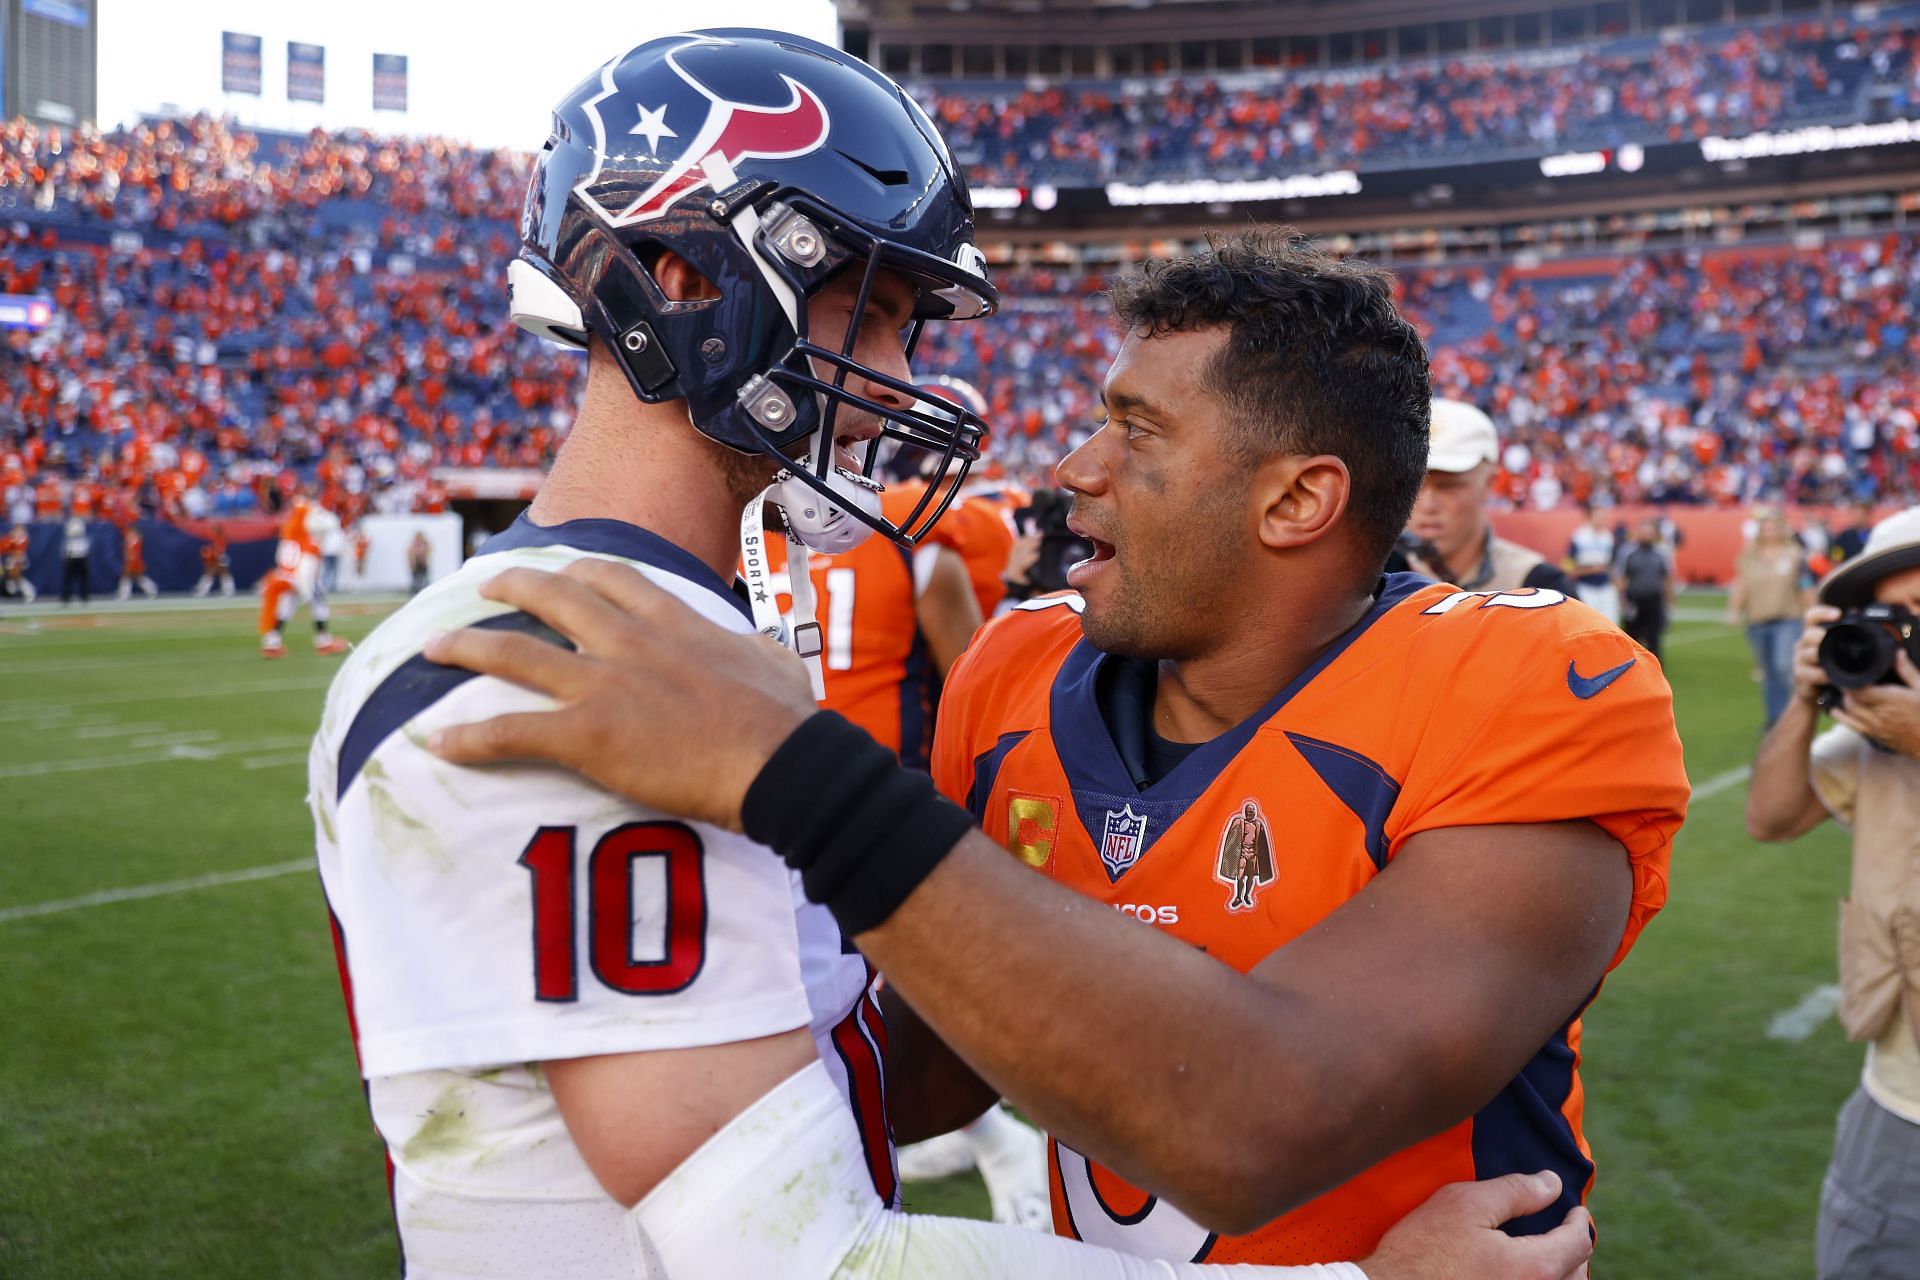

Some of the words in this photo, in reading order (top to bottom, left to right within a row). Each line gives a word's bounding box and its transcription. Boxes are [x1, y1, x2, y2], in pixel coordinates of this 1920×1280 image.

[745, 536, 764, 588] SPORT
[1105, 834, 1132, 862] NFL
[516, 820, 709, 1003] 10
